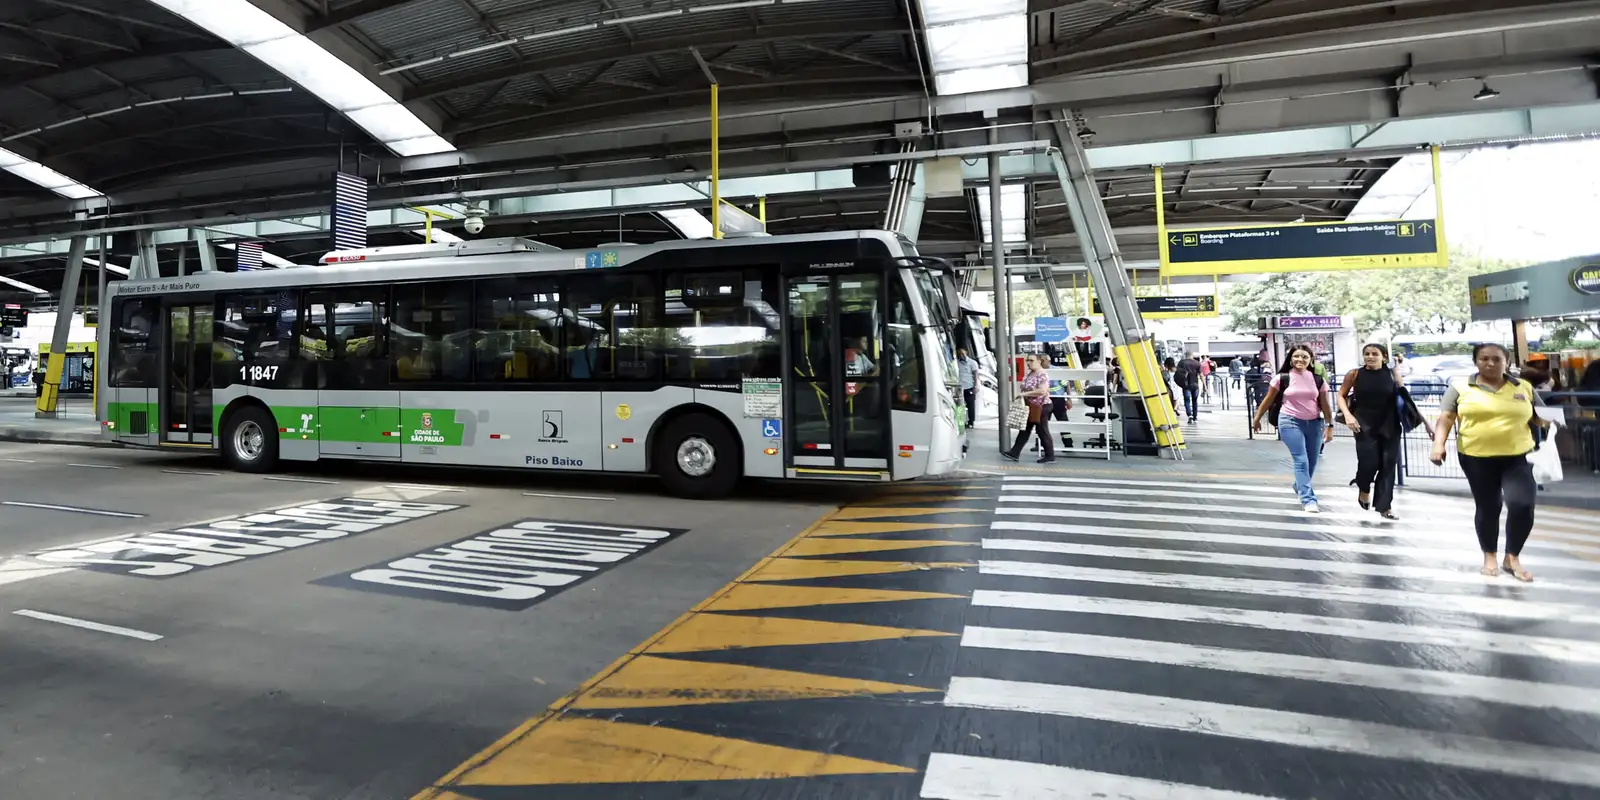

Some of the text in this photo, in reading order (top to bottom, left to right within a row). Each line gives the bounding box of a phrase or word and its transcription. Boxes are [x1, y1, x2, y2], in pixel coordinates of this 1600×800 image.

[1582, 270, 1600, 281] CAF
[137, 285, 151, 293] Euro
[152, 284, 156, 292] 5
[161, 283, 168, 291] Ar
[185, 282, 200, 290] Puro
[411, 434, 445, 443] SÃO PAULO
[525, 455, 583, 467] Piso Baixo
[350, 521, 671, 600] CUIDADO
